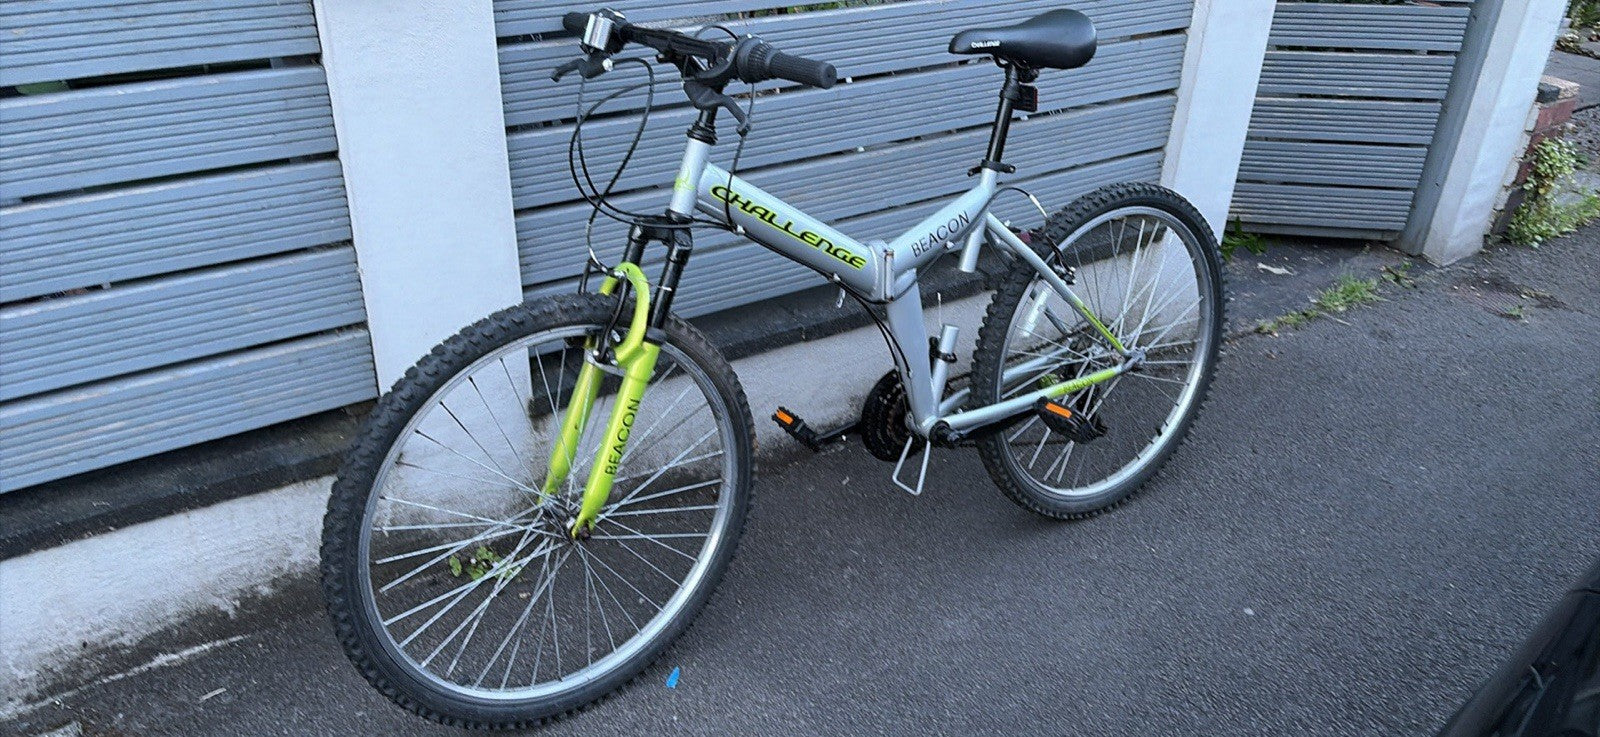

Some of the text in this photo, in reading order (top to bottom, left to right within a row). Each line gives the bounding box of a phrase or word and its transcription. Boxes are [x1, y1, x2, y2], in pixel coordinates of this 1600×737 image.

[710, 186, 867, 270] CHALLENGE
[911, 211, 970, 258] BEACON
[604, 398, 640, 476] BEACON
